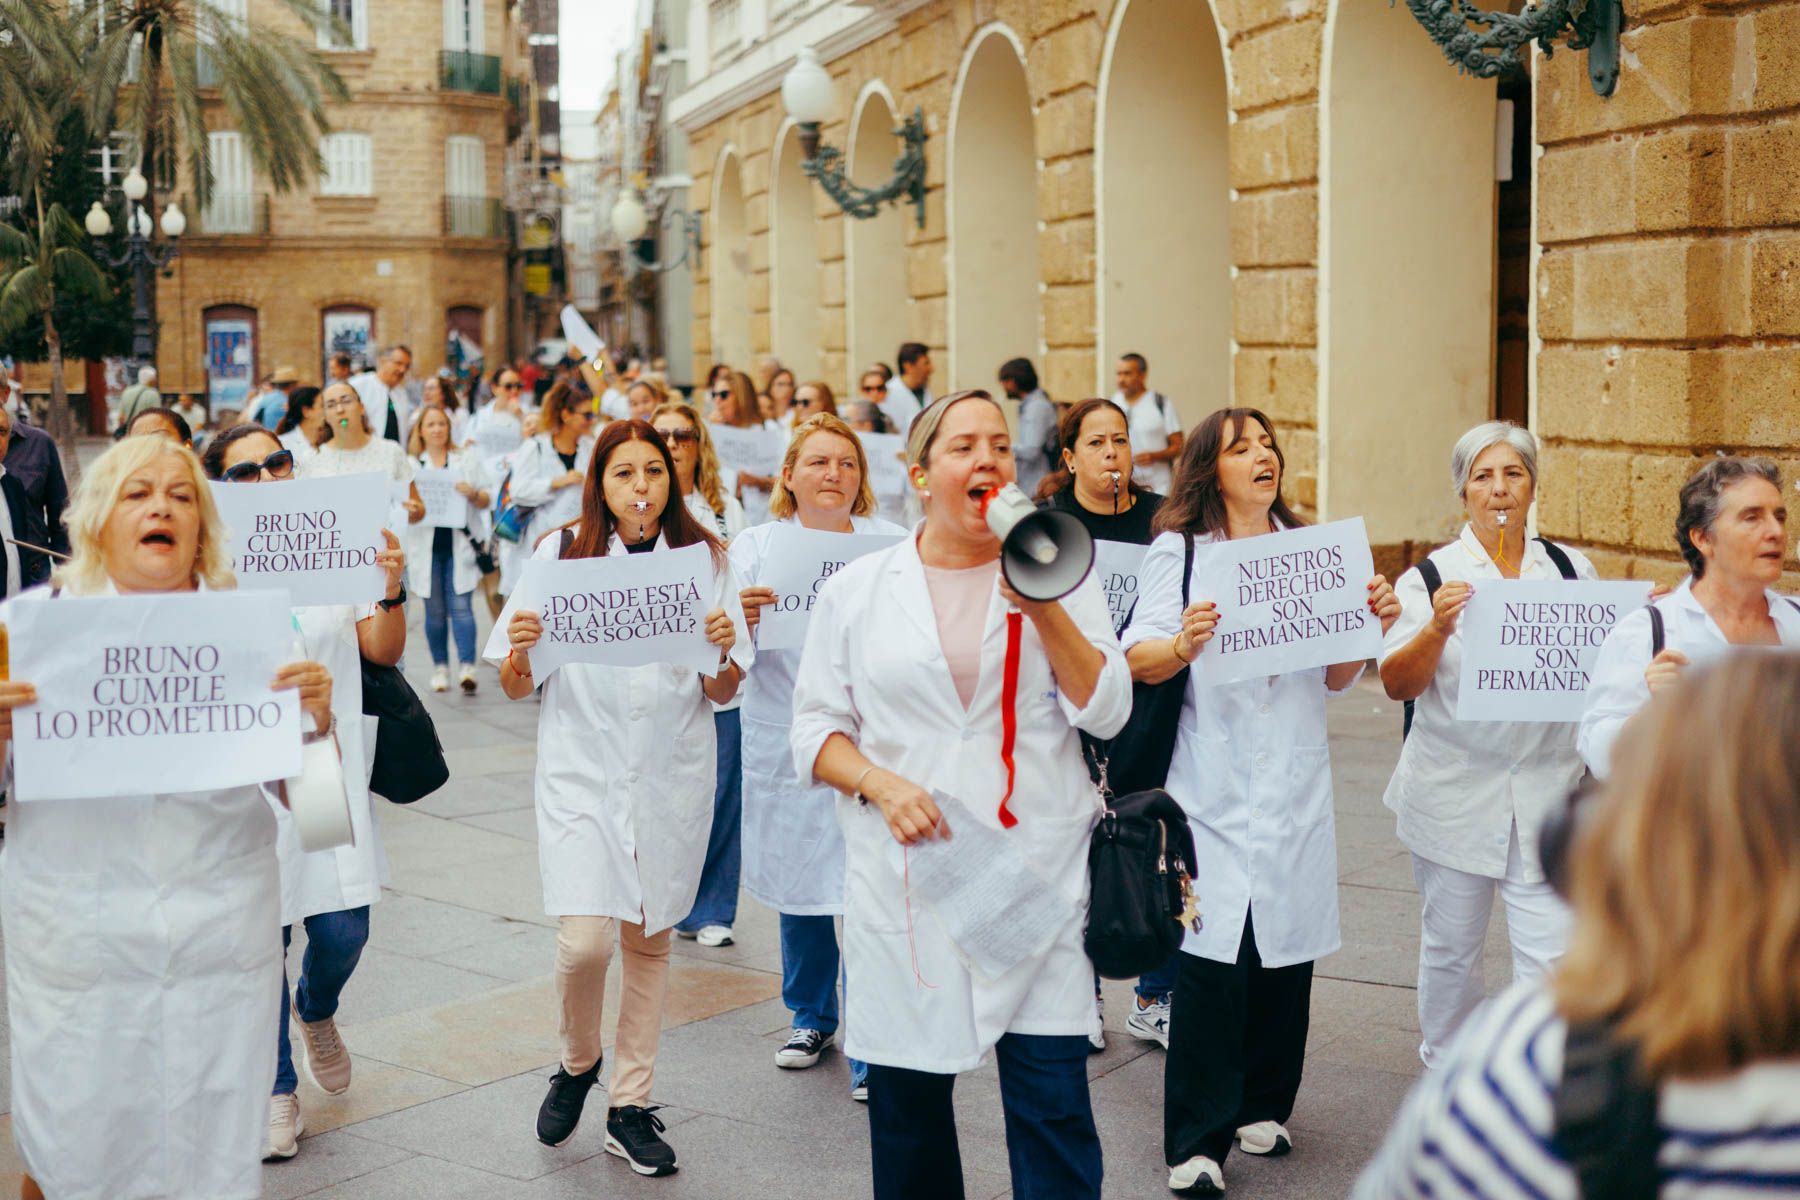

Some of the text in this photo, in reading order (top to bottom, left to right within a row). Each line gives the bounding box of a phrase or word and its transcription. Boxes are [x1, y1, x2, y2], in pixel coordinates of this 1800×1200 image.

[255, 510, 336, 533] BRUNO
[248, 530, 342, 553] CUMPLE
[242, 546, 377, 573] PROMETIDO
[1238, 545, 1343, 583] NUESTROS
[542, 576, 701, 622] ¿DONDE ESTÁ
[1238, 567, 1346, 607] DERECHOS
[553, 601, 692, 631] EL ALCALDE
[1271, 596, 1314, 623] SON
[1503, 602, 1617, 624] NUESTROS
[603, 617, 697, 643] SOCIAL?
[1219, 608, 1366, 654] PERMANENTES
[103, 645, 219, 675] BRUNO
[1535, 648, 1580, 669] SON
[93, 675, 226, 706] CUMPLE
[36, 701, 282, 740] LO PROMETIDO
